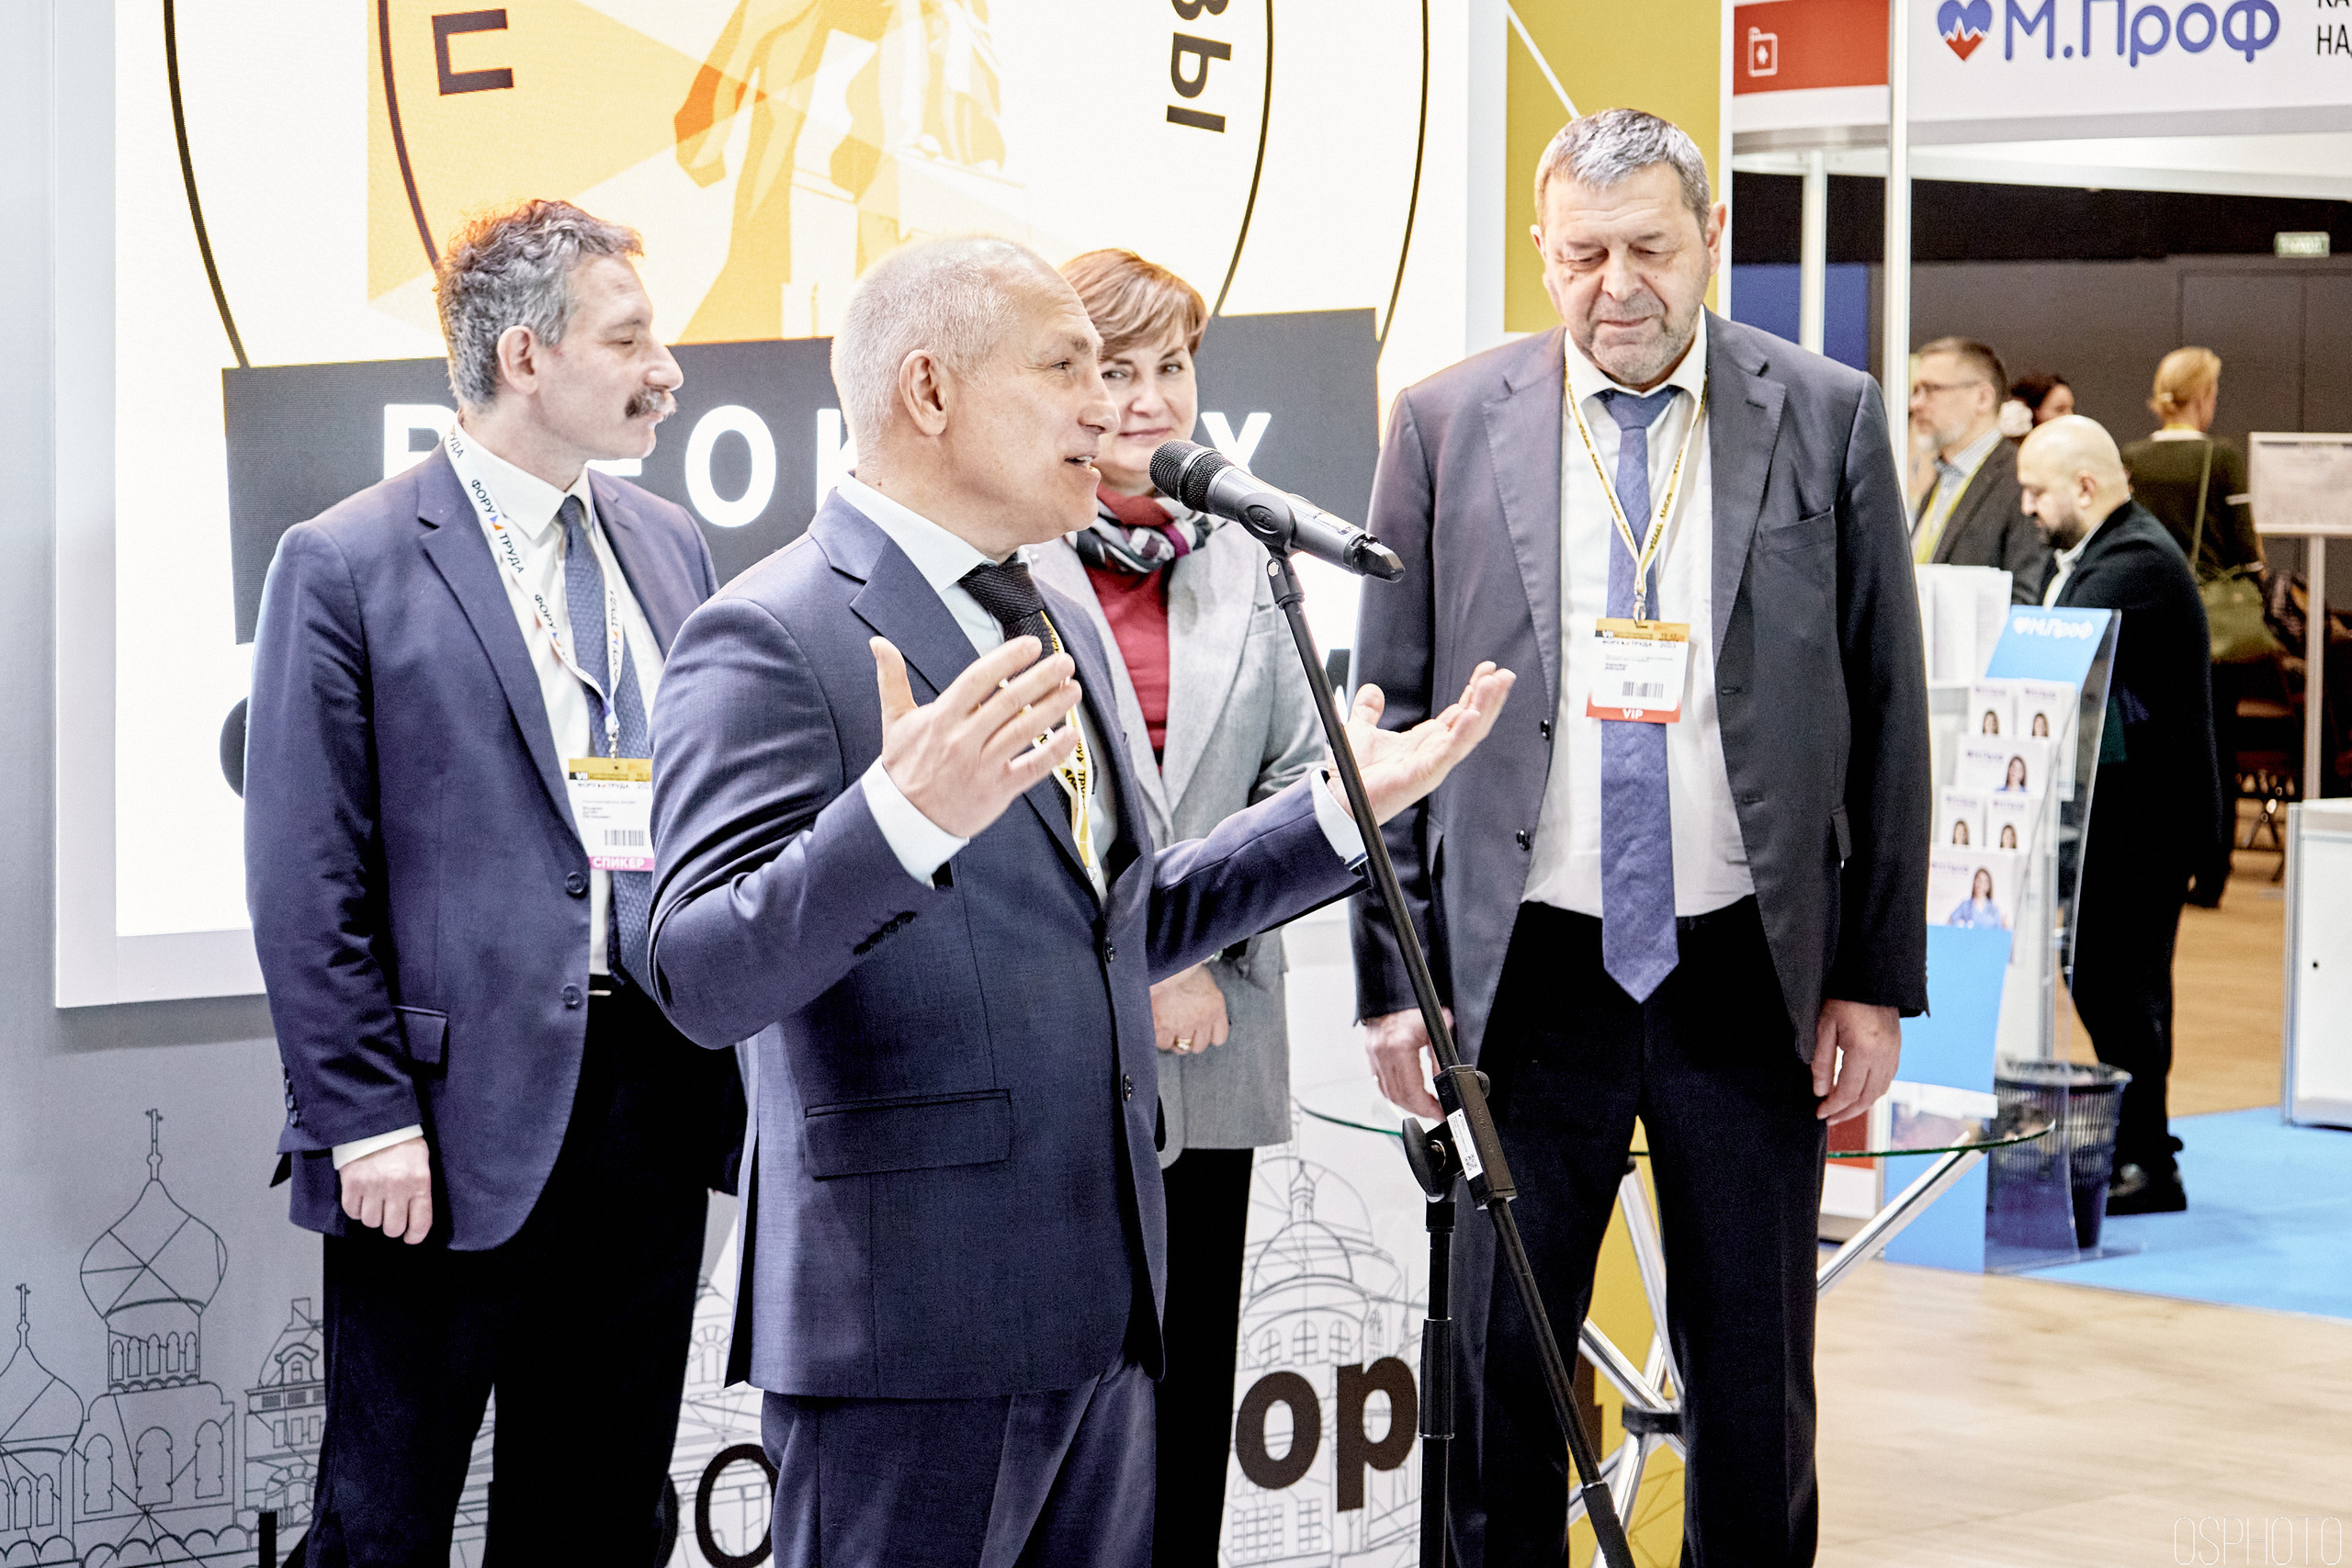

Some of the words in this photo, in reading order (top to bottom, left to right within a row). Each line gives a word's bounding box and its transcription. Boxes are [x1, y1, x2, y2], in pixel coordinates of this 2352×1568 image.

[2317, 24, 2352, 58] НА
[499, 532, 526, 575] ТРУДА
[1623, 708, 1644, 720] VIP
[593, 856, 645, 870] СПИКЕР
